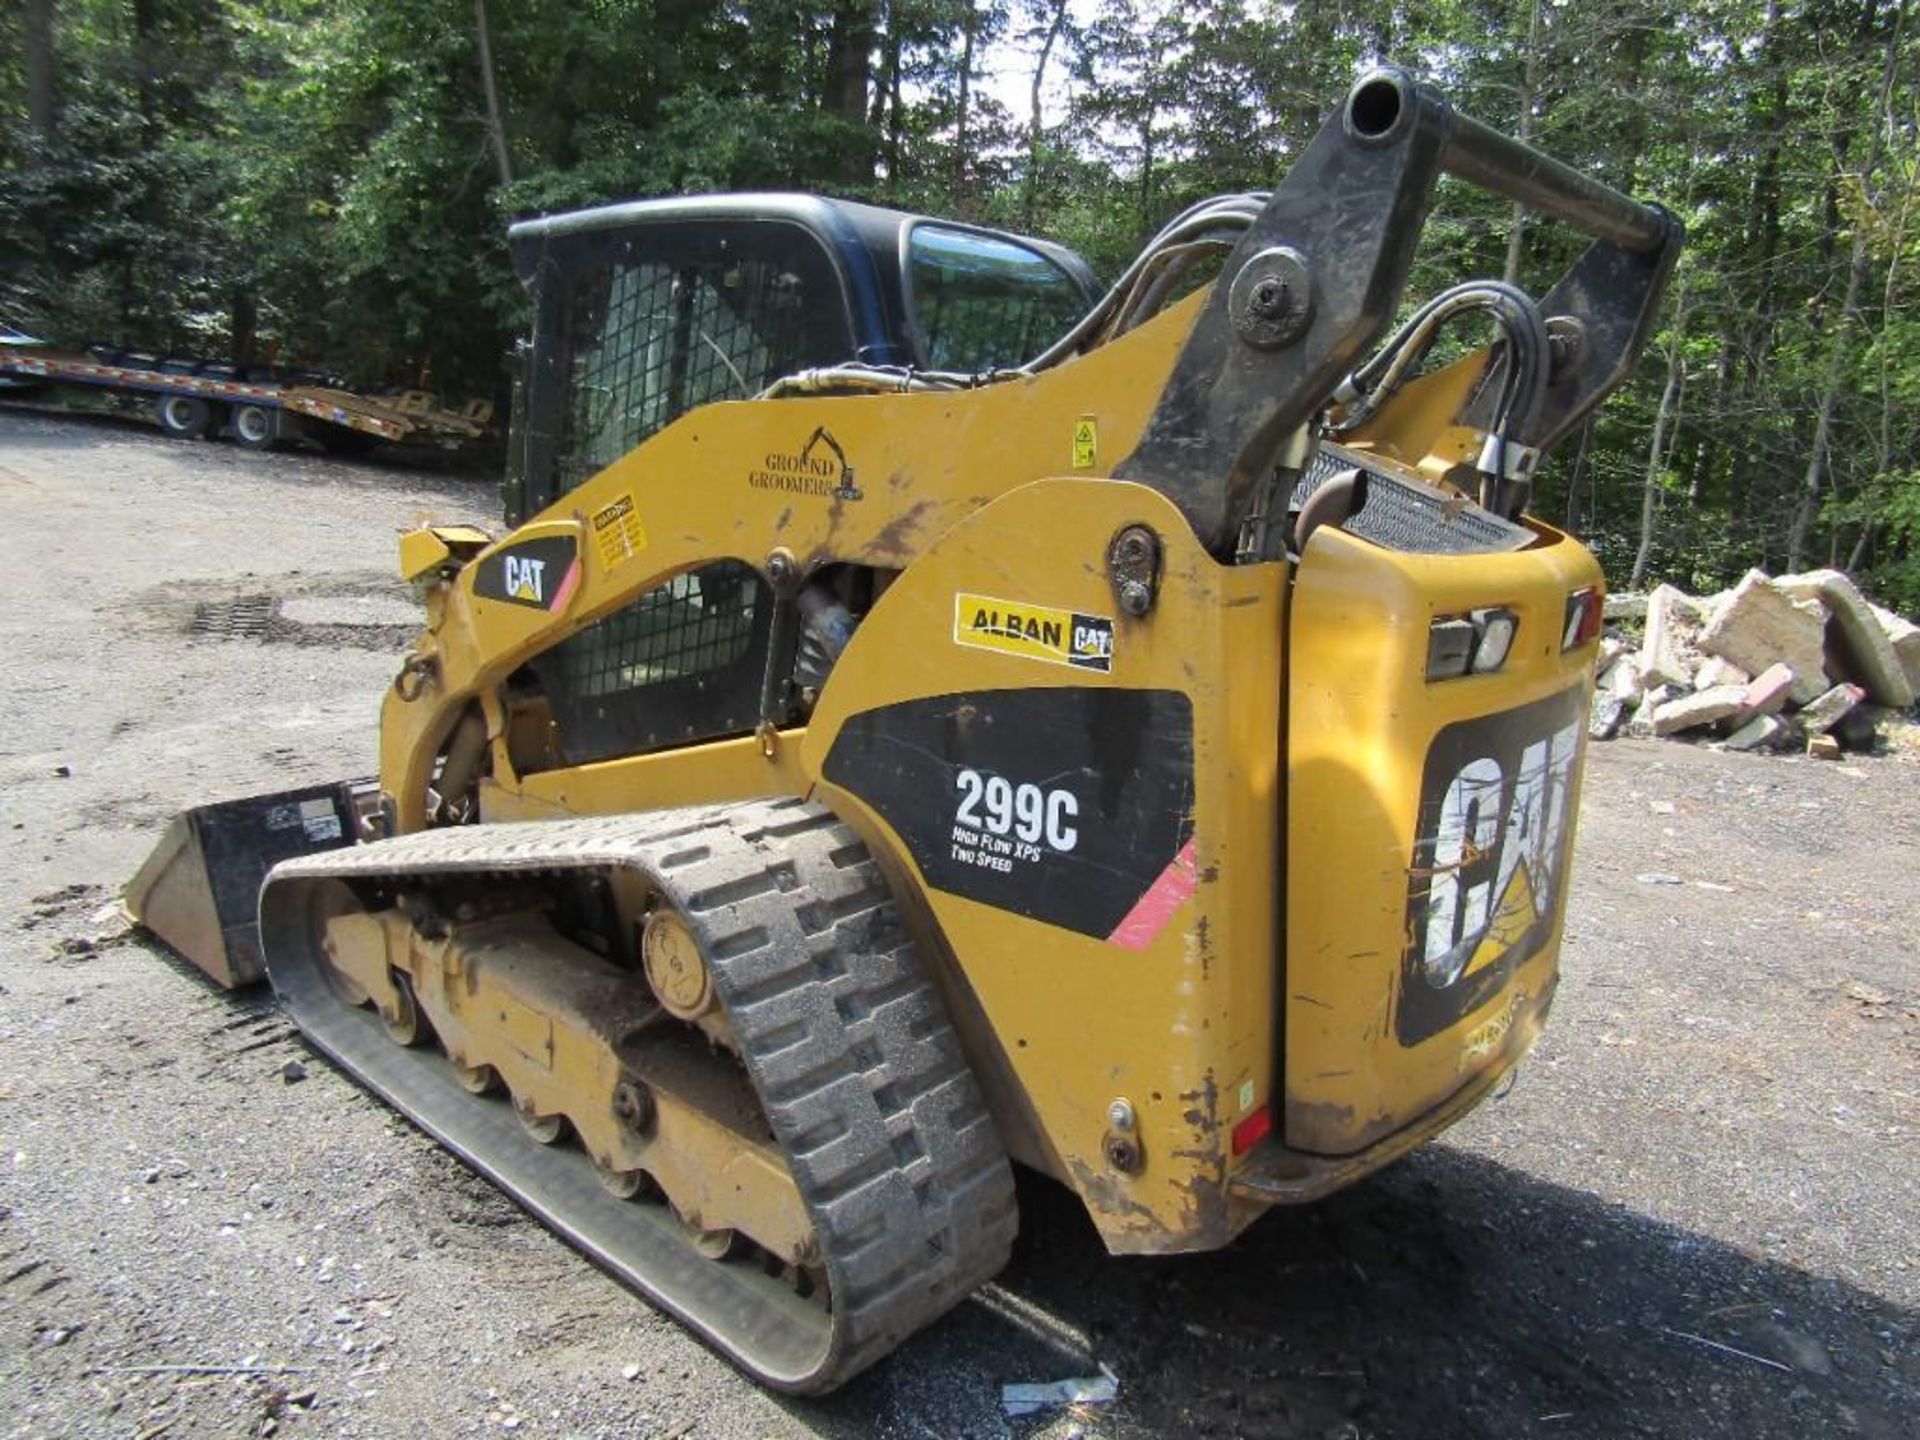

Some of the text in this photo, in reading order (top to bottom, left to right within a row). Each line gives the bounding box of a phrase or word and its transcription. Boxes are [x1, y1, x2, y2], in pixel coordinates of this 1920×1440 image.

[765, 453, 835, 476] GROUND
[505, 555, 546, 603] CAT
[973, 608, 1108, 657] ALBAN CAT
[956, 769, 1079, 851] 299C
[951, 844, 1013, 873] TWO SPEED
[980, 833, 1013, 855] FLOW
[1013, 841, 1042, 862] XPS
[1425, 720, 1580, 990] CAT
